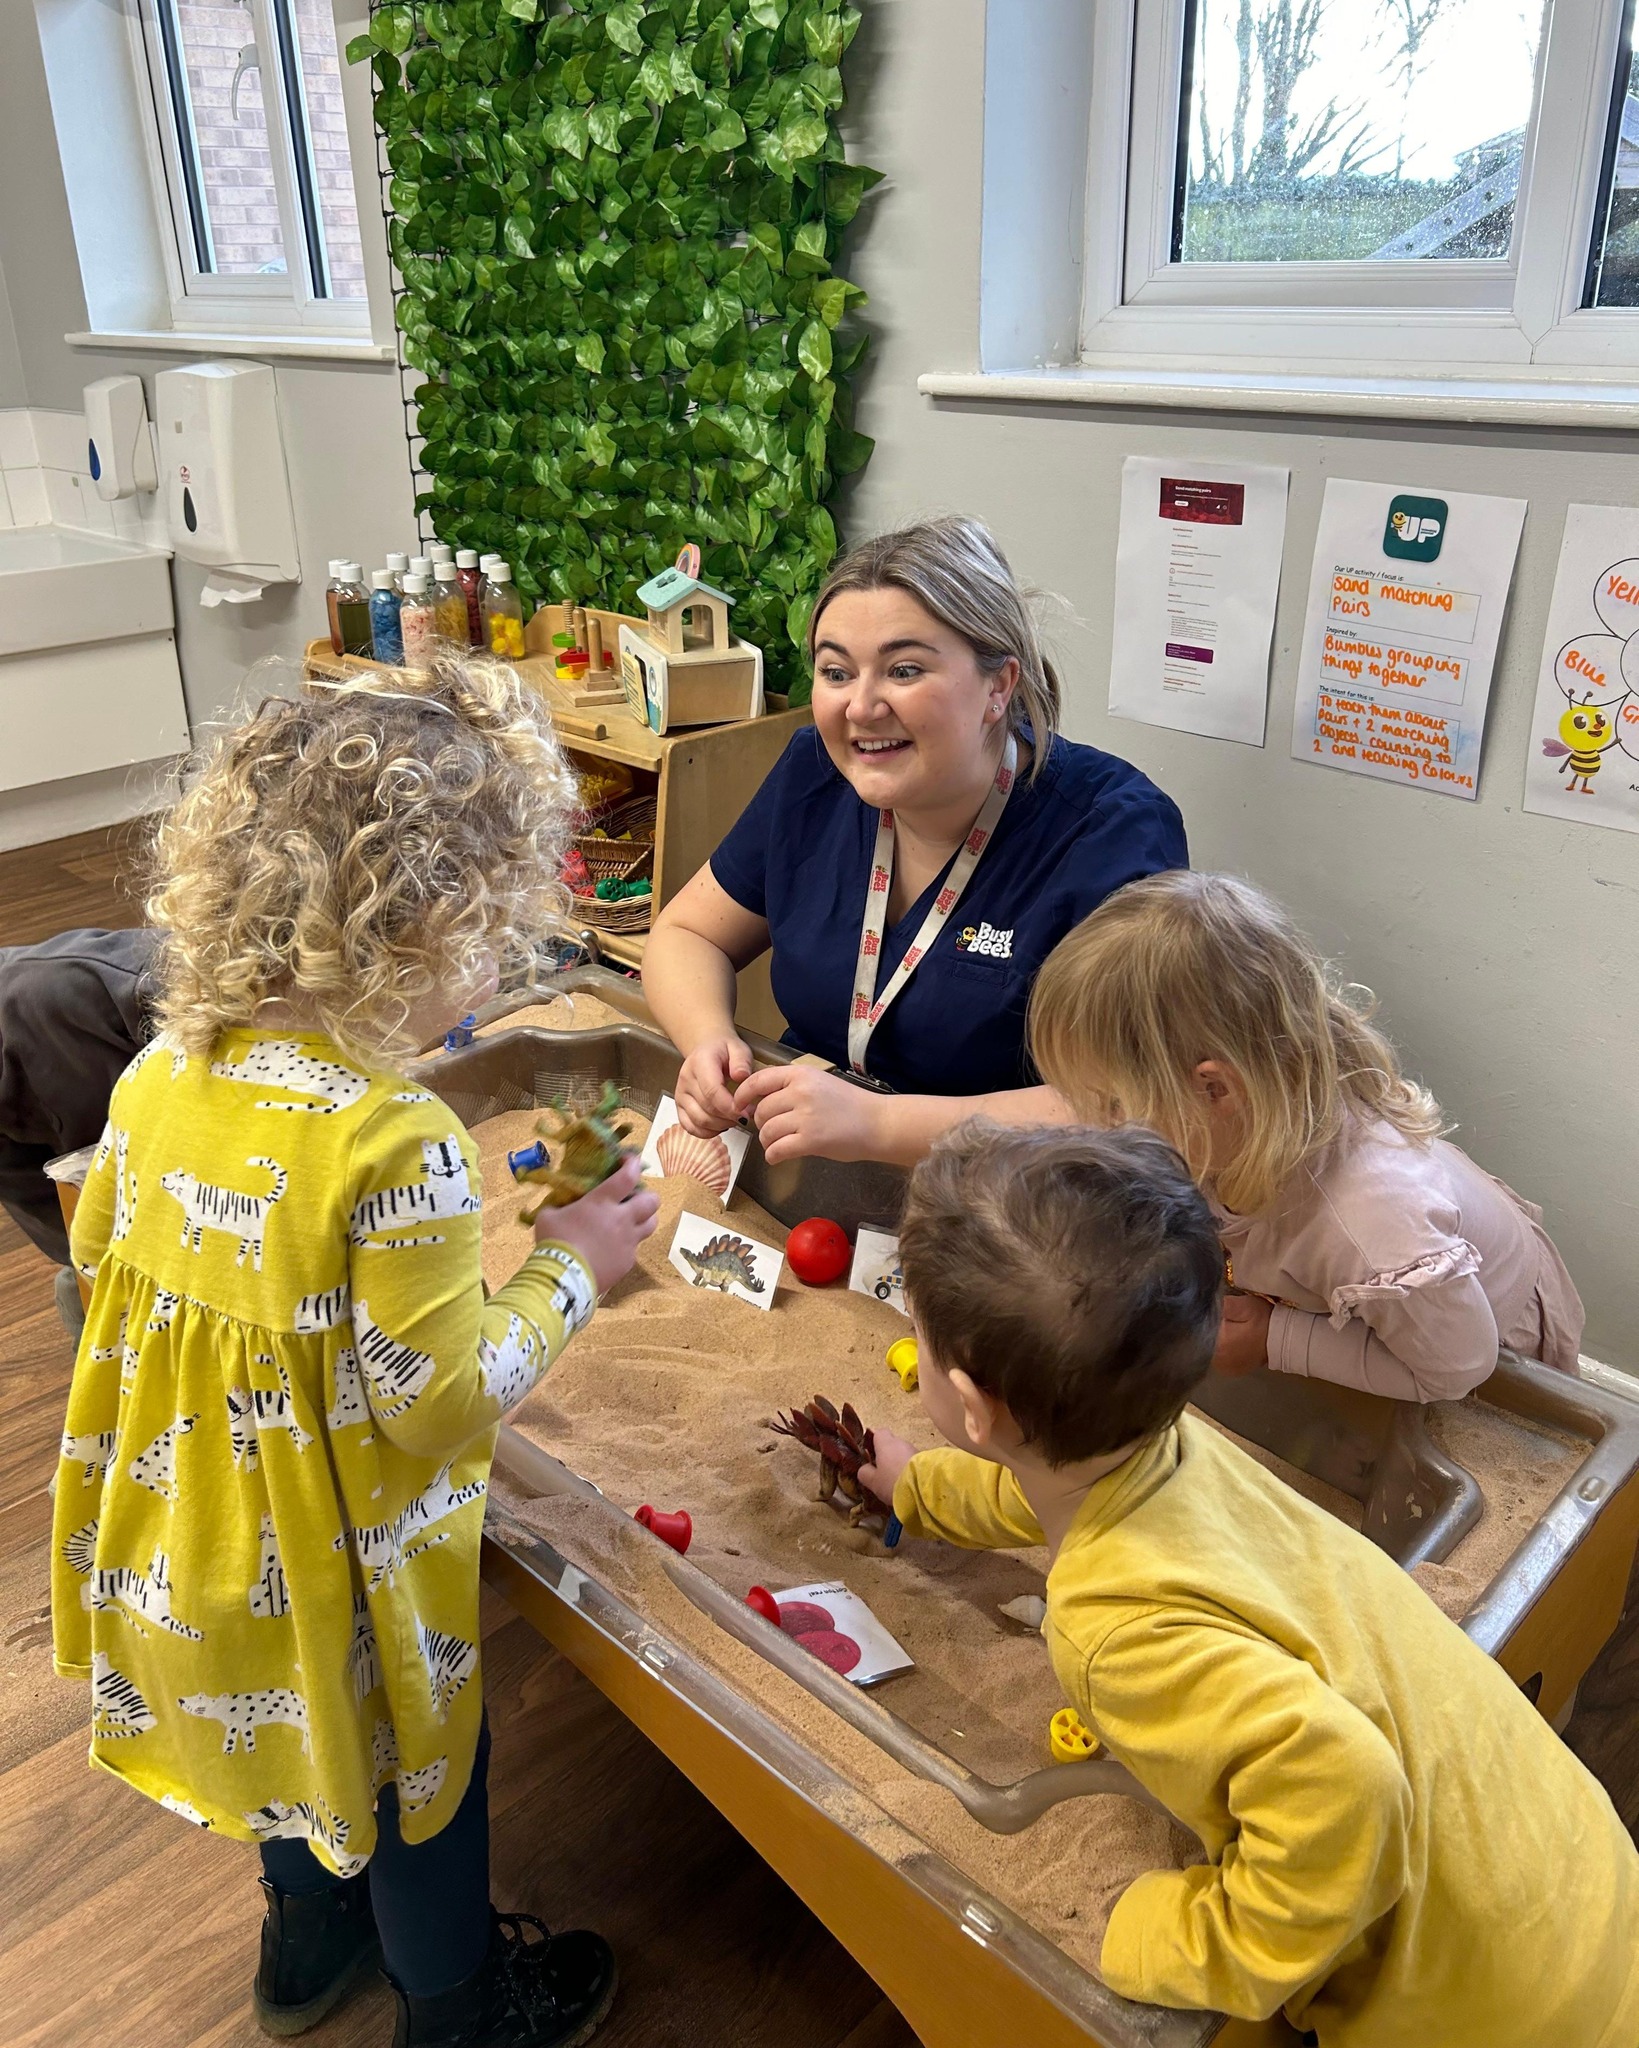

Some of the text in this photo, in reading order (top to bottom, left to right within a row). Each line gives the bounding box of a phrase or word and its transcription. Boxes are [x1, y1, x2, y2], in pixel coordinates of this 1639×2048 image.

[1398, 516, 1440, 543] UP
[1355, 569, 1376, 578] activity
[1381, 572, 1397, 580] focus
[1607, 575, 1639, 606] Yell
[1326, 626, 1348, 635] Inspired
[1322, 654, 1363, 679] things
[1387, 649, 1461, 680] grouping
[1564, 650, 1607, 687] Blue
[1336, 699, 1366, 715] teach
[1368, 703, 1402, 721] them
[1405, 711, 1448, 731] about
[1366, 718, 1375, 732] 2
[1381, 724, 1449, 753] matching
[1313, 738, 1323, 752] 2
[1331, 744, 1356, 758] and
[1361, 749, 1418, 779] teaching
[1435, 752, 1452, 764] to
[978, 921, 1014, 945] Busy
[967, 936, 1013, 959] Bees
